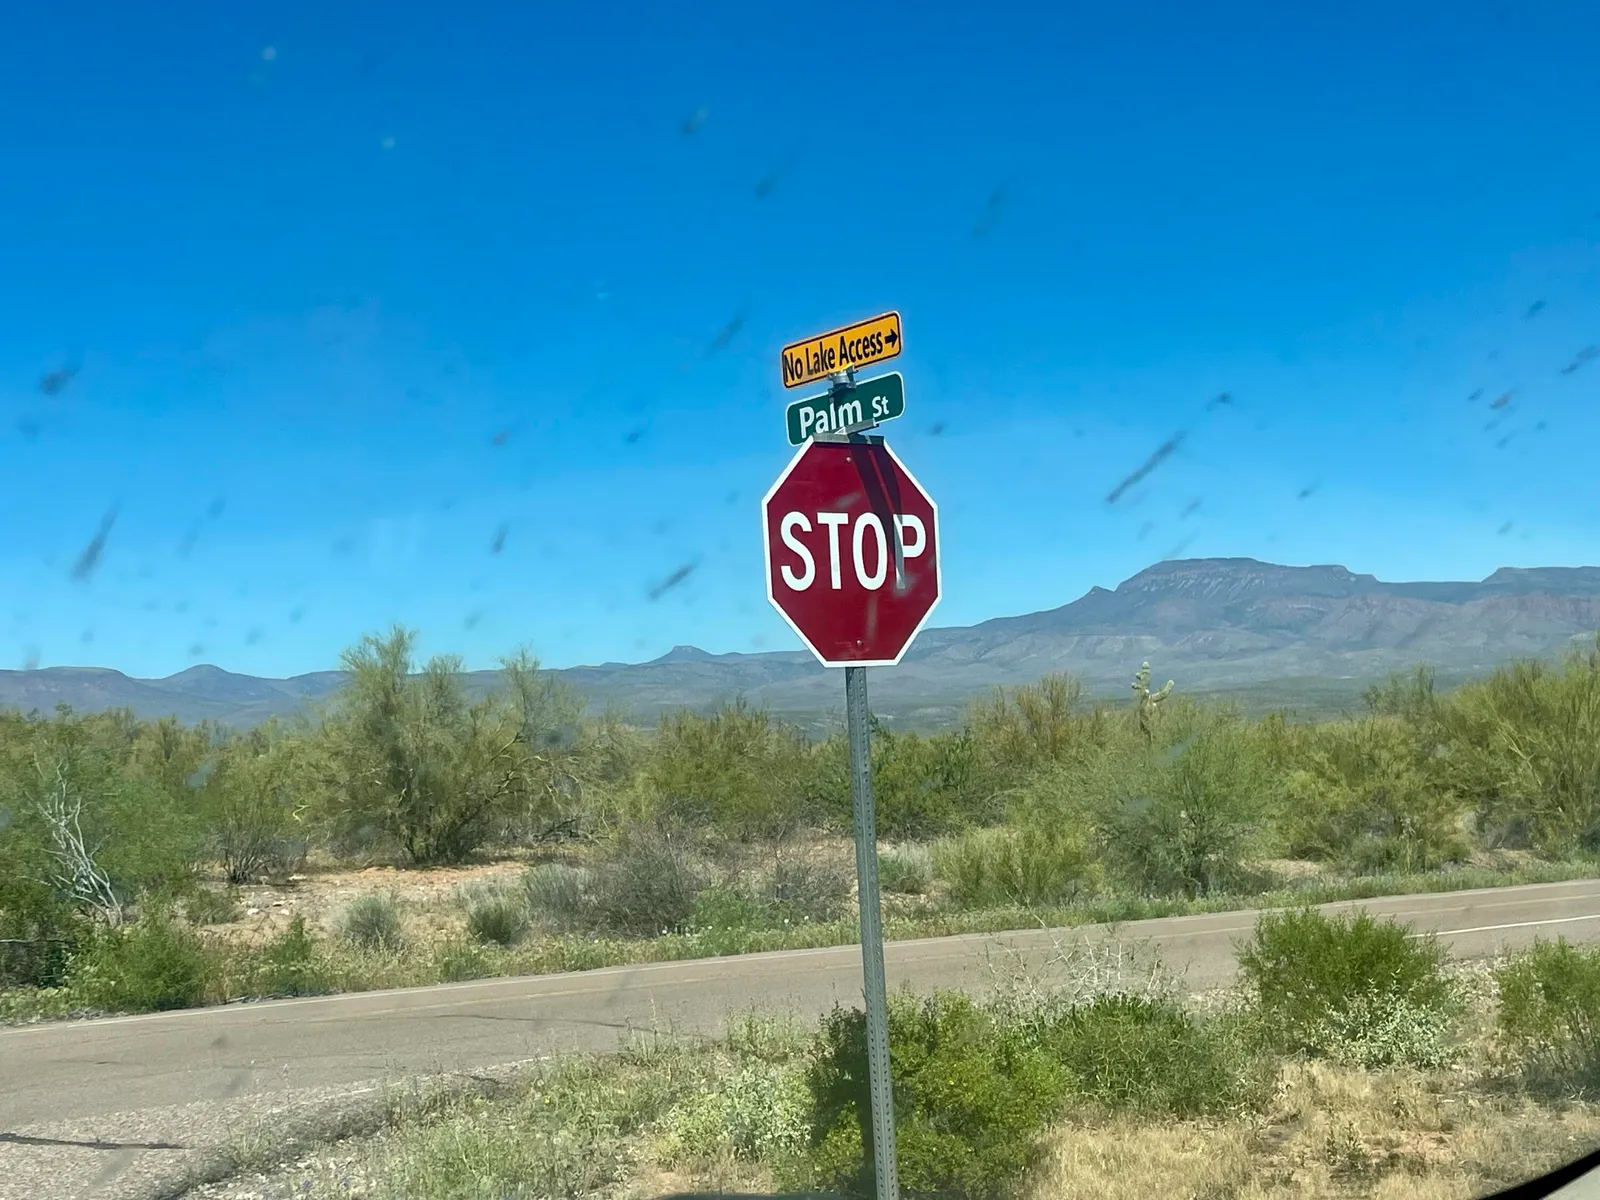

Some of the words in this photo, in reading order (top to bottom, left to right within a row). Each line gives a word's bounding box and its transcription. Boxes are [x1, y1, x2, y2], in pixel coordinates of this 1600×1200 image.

[783, 353, 803, 382] No
[806, 341, 835, 375] Lake
[839, 331, 883, 366] Access
[799, 400, 862, 438] Palm
[872, 396, 889, 418] St
[780, 511, 926, 592] STOP
